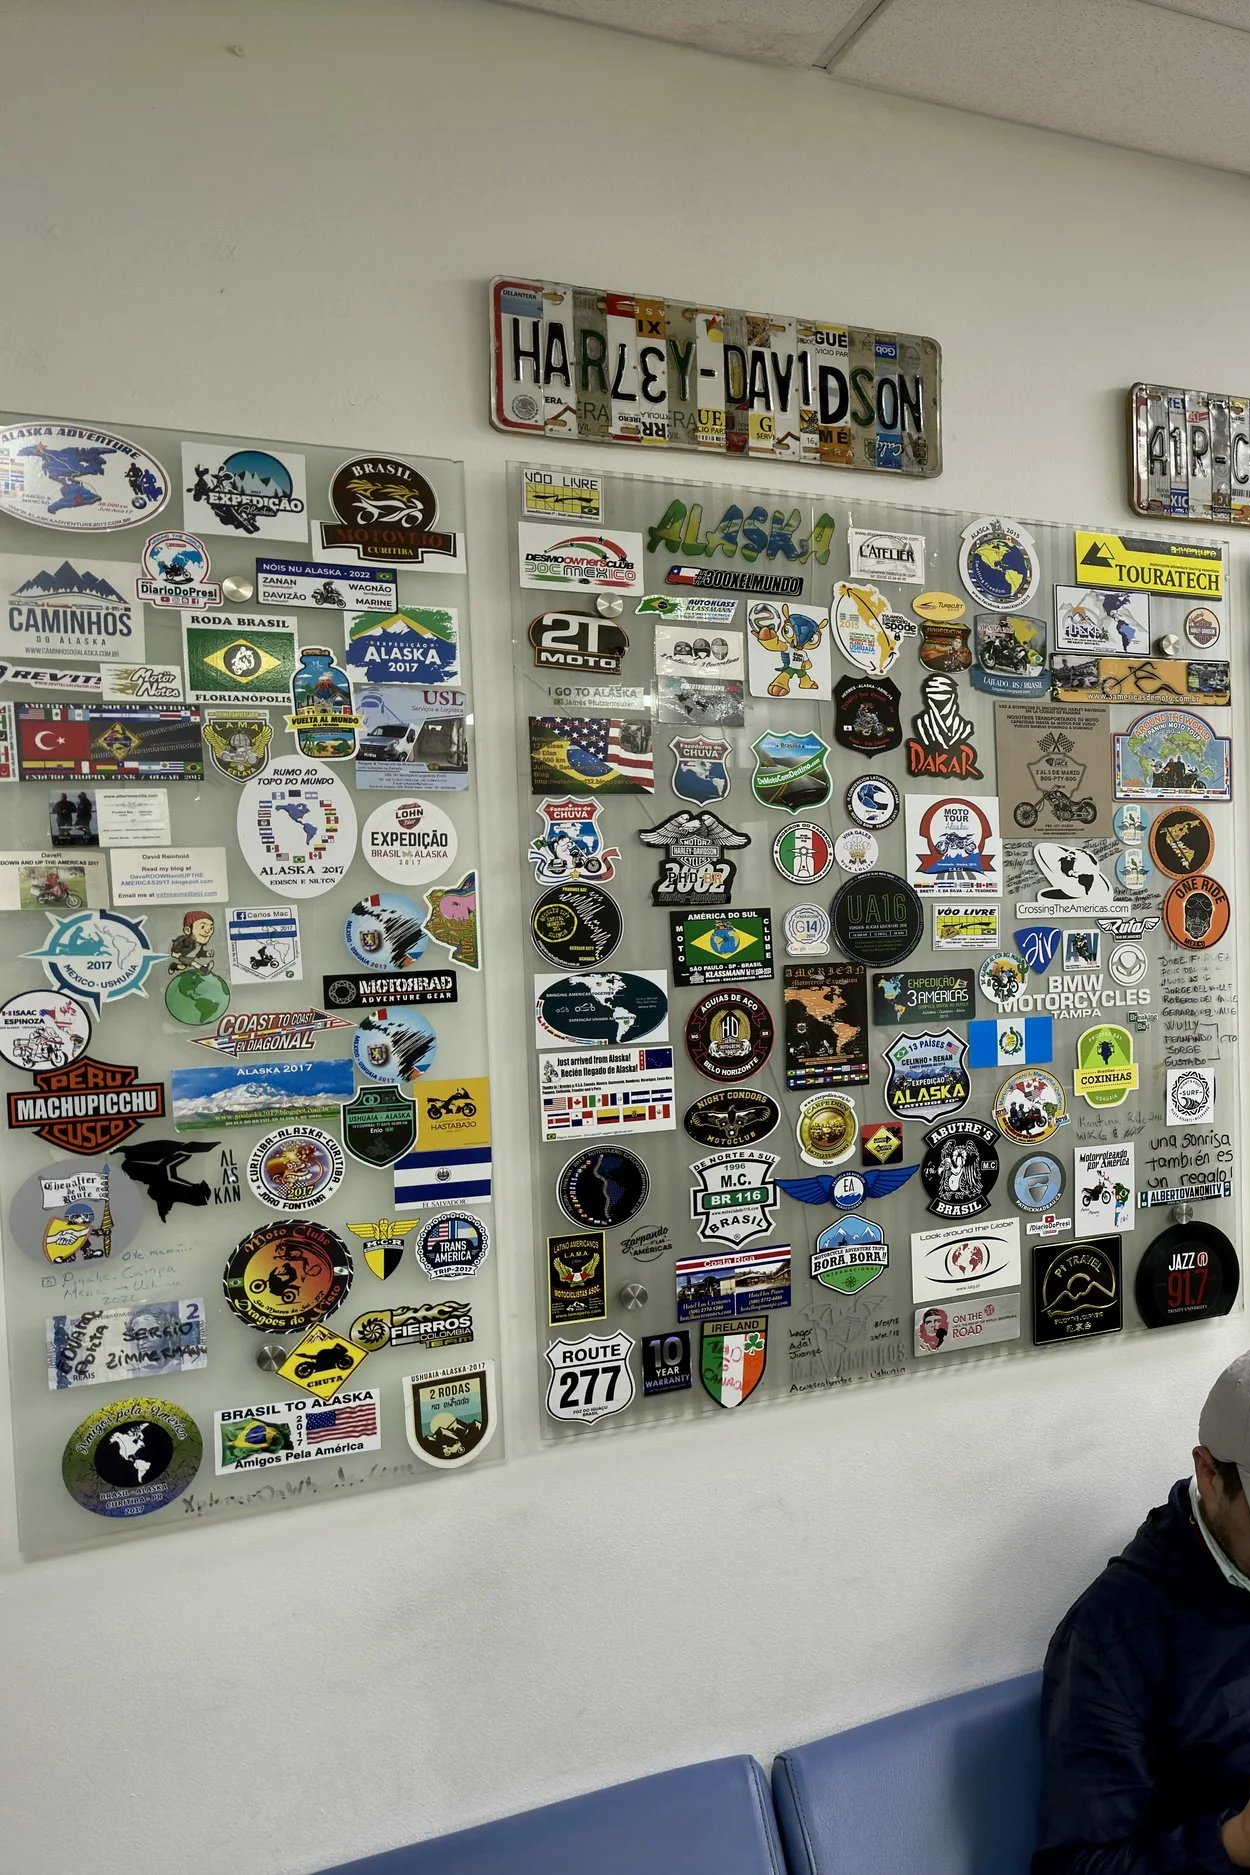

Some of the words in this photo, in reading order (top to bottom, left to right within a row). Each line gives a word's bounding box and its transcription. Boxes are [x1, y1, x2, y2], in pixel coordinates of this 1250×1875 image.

[1, 426, 63, 446] ALASKA
[66, 427, 141, 461] ADVENTURE
[351, 462, 413, 481] BRASIL
[525, 472, 552, 485] VÔO
[563, 476, 598, 490] LIVRE
[208, 492, 303, 514] EXPEDIÇÃO
[648, 499, 835, 565] ALASKA
[367, 545, 414, 556] CURITIBA
[859, 543, 915, 562] L'ATELIER
[694, 570, 800, 593] #300XELMUNDO
[1115, 565, 1220, 591] TOURATECH
[141, 582, 218, 599] DiarioDoPresi
[9, 608, 132, 637] CAMINHOS
[191, 615, 233, 626] RODA
[239, 617, 290, 628] BRASIL
[364, 646, 441, 667] ALASKA
[540, 652, 616, 668] MOTO
[388, 661, 418, 673] 2017
[195, 693, 292, 704] FLORIANÓPOLIS
[423, 690, 463, 706] USL
[1088, 692, 1200, 703] www.3americasdemoto.com.br
[291, 716, 317, 726] VUELTA
[319, 716, 328, 726] AL
[330, 715, 359, 725] MUNDO
[683, 749, 719, 758] CHUVA
[909, 741, 978, 777] DAKAR
[757, 758, 820, 786] DeMotoComDestino.com
[257, 777, 281, 785] TOPO
[283, 777, 296, 785] DO
[299, 777, 334, 785] MUNDO
[944, 808, 969, 816] MOTO
[944, 815, 968, 823] TOUR
[370, 829, 448, 849] EXPEDIÇÃO
[667, 872, 723, 885] PHD-BR
[1175, 880, 1199, 901] ONE
[1200, 879, 1226, 905] RIDE
[687, 912, 722, 920] AMÉRICA
[725, 911, 739, 919] DO
[742, 910, 758, 918] SUL
[1018, 904, 1129, 917] CrossingTheAmericas.com
[359, 976, 453, 994] MOTORRAD
[907, 976, 955, 989] EXPEDIÇÃO
[1049, 974, 1104, 992] BMW
[362, 994, 415, 1003] ADVENTURE
[420, 993, 451, 1002] GEAR
[907, 990, 917, 1005] 3
[917, 988, 969, 1003] AMÉRICAS
[997, 989, 1151, 1013] MOTORCYCLES
[1051, 1008, 1102, 1020] TAMPA
[283, 1063, 313, 1074] 2017
[557, 1057, 569, 1068] Just
[570, 1055, 591, 1067] arrived
[593, 1054, 608, 1065] from
[609, 1053, 631, 1064] Alaska!
[561, 1067, 581, 1079] Recién
[582, 1065, 604, 1079] llegado
[606, 1065, 614, 1075] de
[615, 1063, 638, 1074] Alaska!
[1081, 1071, 1132, 1085] COXINHAS
[50, 1071, 123, 1091] PERU
[16, 1089, 157, 1120] MACHUPICCHU
[697, 1094, 727, 1109] NIGHT
[728, 1092, 767, 1103] CONDORS
[53, 1121, 124, 1147] CUSCO
[931, 1124, 994, 1143] ABUTRE'S
[1150, 1135, 1177, 1149] una
[1183, 1129, 1232, 1149] sonrisa
[1145, 1148, 1210, 1172] también
[1217, 1150, 1234, 1163] es
[720, 1172, 752, 1188] M.C.
[1147, 1173, 1168, 1188] un
[711, 1193, 733, 1205] BR
[736, 1190, 761, 1202] 116
[1151, 1184, 1222, 1204] ALBERTOVANONITV
[936, 1201, 982, 1217] BRASIL
[709, 1213, 764, 1235] BRASIL
[439, 1242, 467, 1252] TRANS
[435, 1252, 471, 1262] AMERICA
[851, 1249, 887, 1265] BORA!!
[1168, 1254, 1195, 1272] JAZZ
[1167, 1268, 1208, 1307] 91.7
[391, 1316, 471, 1336] FIERROS
[711, 1320, 759, 1333] IRELAND
[563, 1344, 621, 1363] ROUTE
[649, 1336, 682, 1366] 10
[656, 1366, 680, 1376] YEAR
[307, 1374, 343, 1389] CHUTA
[429, 1387, 437, 1396] 2
[439, 1382, 471, 1395] RODAS
[559, 1365, 622, 1409] 277
[645, 1374, 690, 1389] WARRANTY
[221, 1406, 281, 1422] BRASIL
[285, 1402, 306, 1412] TO
[311, 1391, 373, 1408] ALASKA
[235, 1453, 283, 1469] Amigos
[286, 1450, 311, 1461] Pela
[315, 1442, 364, 1456] América
